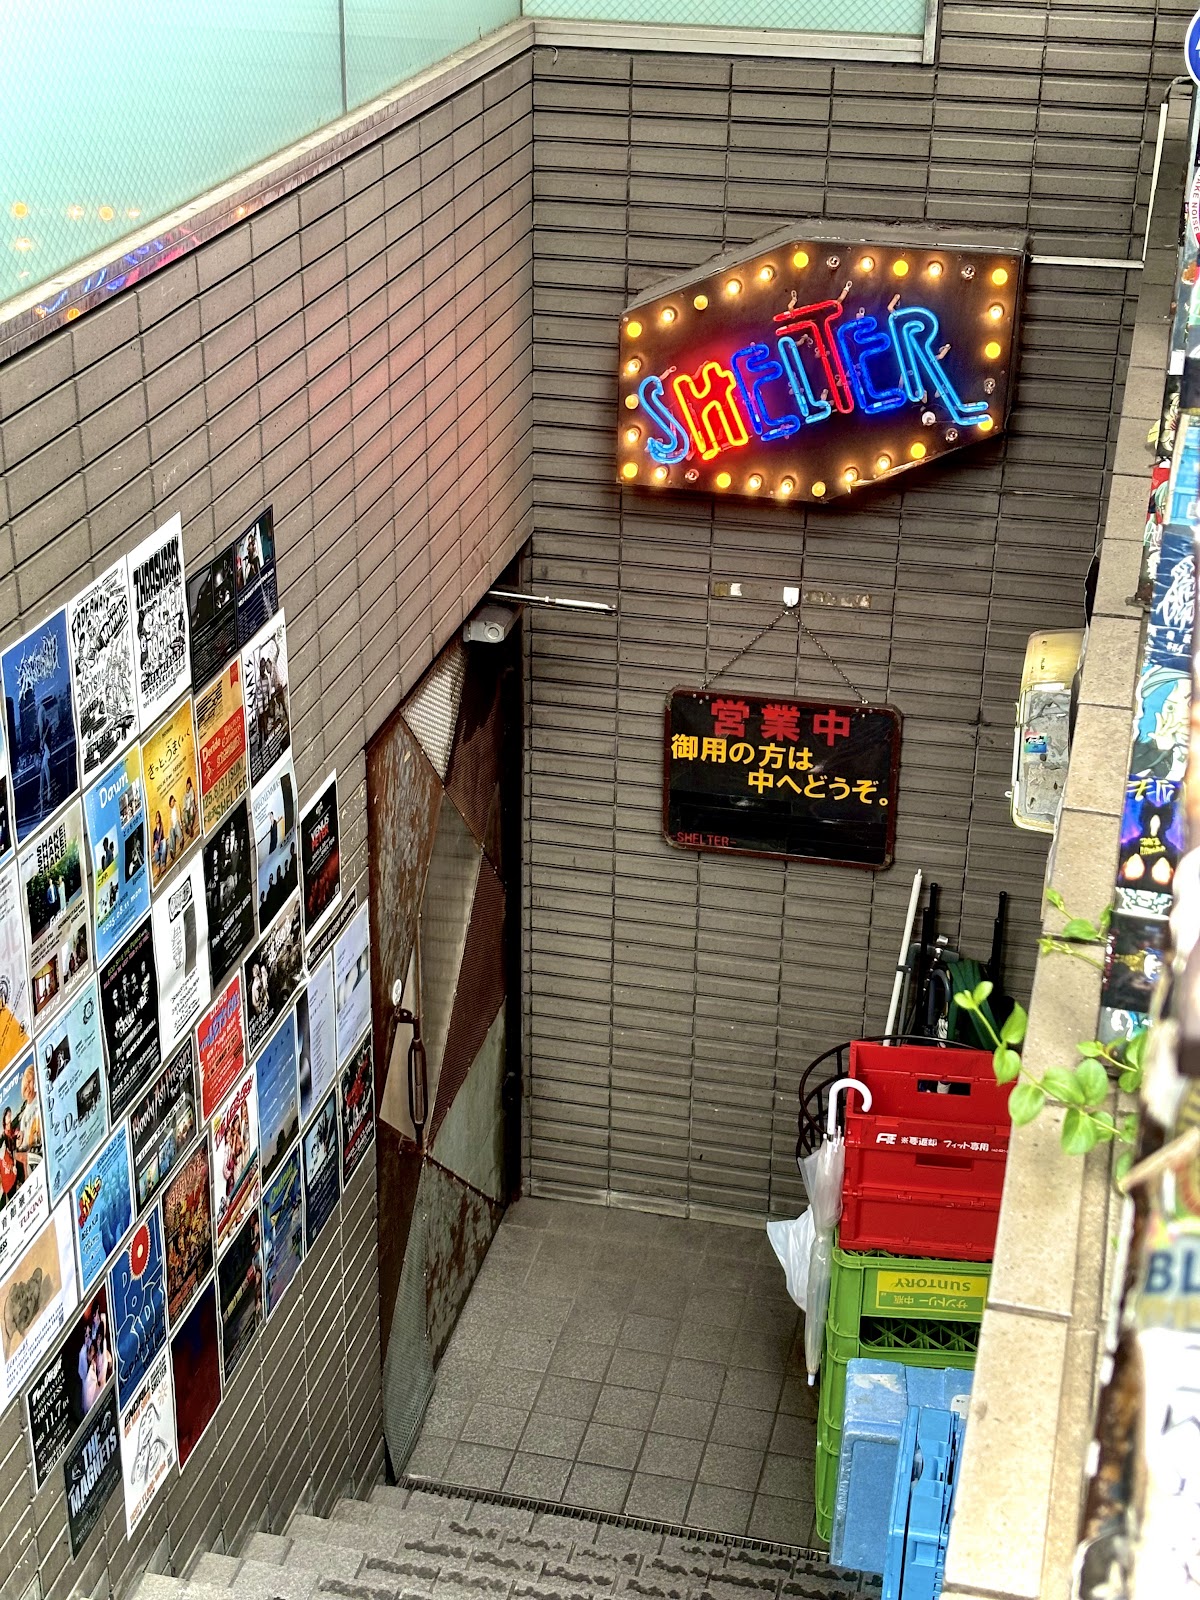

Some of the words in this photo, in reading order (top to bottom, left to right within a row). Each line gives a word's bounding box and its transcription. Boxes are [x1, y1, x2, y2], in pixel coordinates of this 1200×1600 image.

[638, 299, 990, 464] SHELTER
[711, 699, 851, 747] 営業中
[671, 733, 813, 771] 御用の方は
[99, 771, 129, 808] Dawn
[215, 773, 247, 821] SHELTER
[747, 768, 889, 806] 中へどうぞ。
[36, 822, 65, 857] SHAKE!
[37, 832, 66, 868] SHAKE!
[38, 842, 67, 878] SHAKE!
[895, 1278, 971, 1292] SUNTORY
[919, 1296, 968, 1309] サントリー
[44, 1397, 62, 1434] 11.7
[81, 1423, 101, 1473] THE
[69, 1422, 117, 1521] MAGNETS
